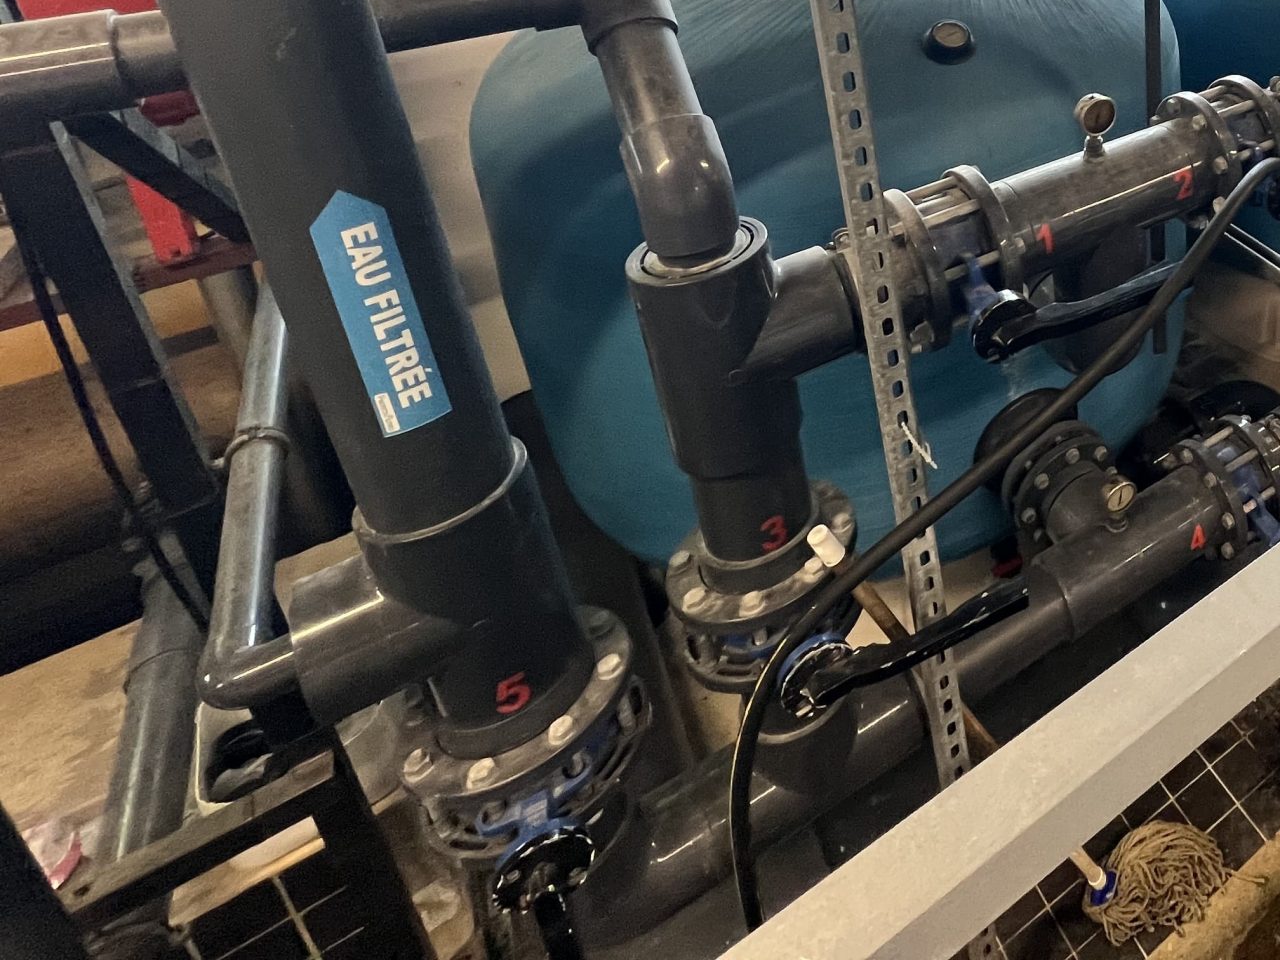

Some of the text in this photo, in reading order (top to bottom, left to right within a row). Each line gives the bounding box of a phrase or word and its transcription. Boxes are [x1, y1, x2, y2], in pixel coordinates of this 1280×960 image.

[1173, 168, 1193, 200] 2
[1036, 223, 1054, 254] 1
[340, 222, 433, 409] EAU FILTRÉE
[760, 514, 787, 551] 3
[1190, 523, 1207, 551] 4
[495, 671, 531, 714] 5
